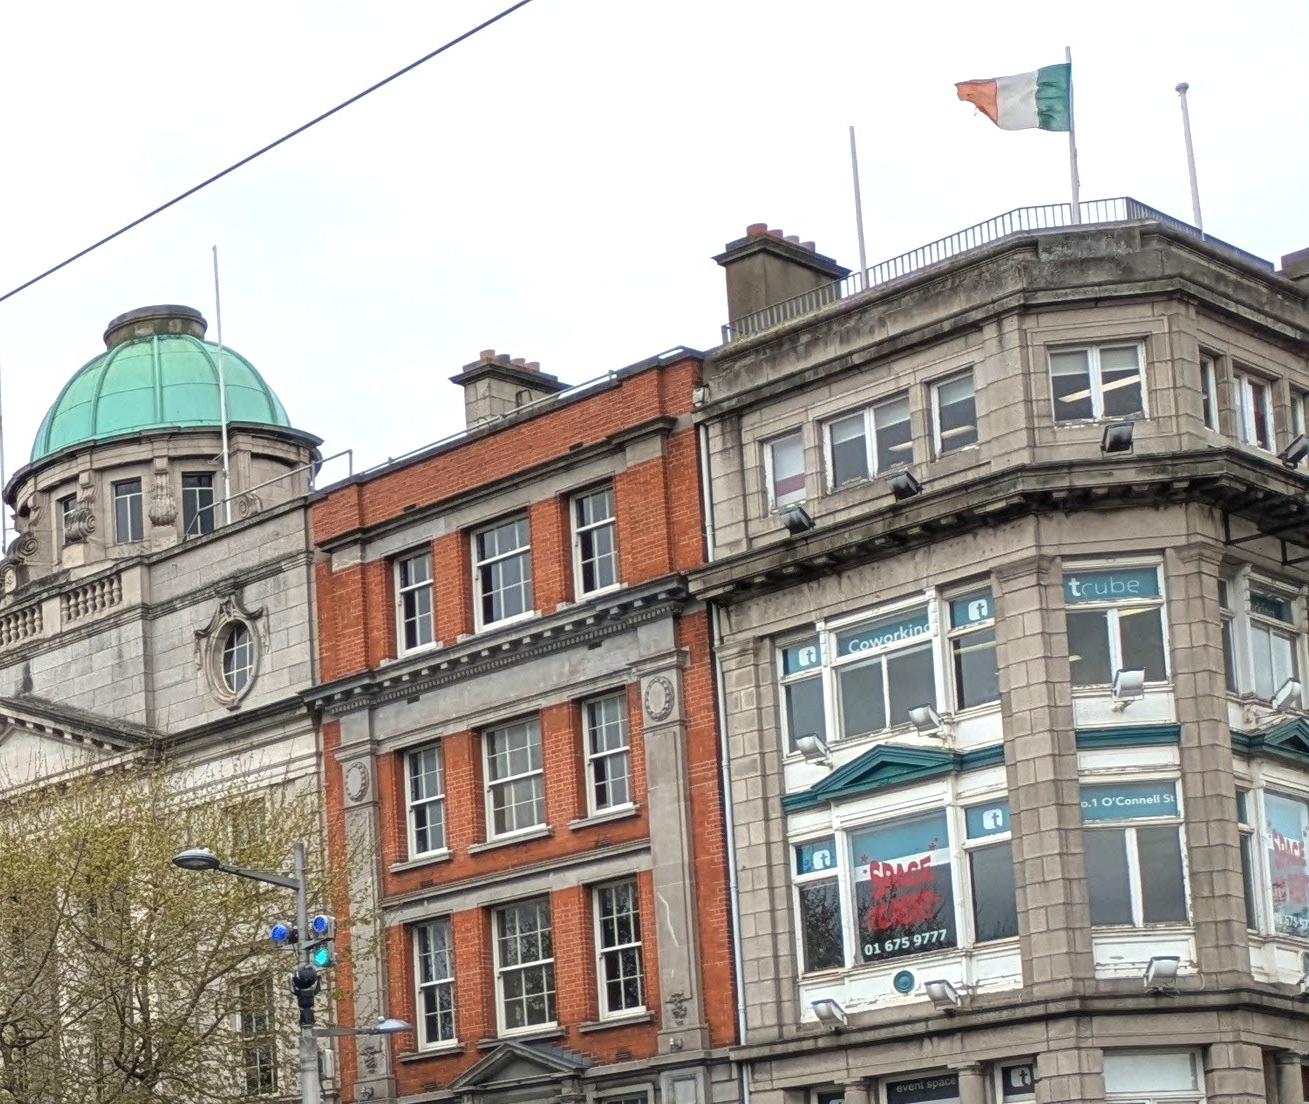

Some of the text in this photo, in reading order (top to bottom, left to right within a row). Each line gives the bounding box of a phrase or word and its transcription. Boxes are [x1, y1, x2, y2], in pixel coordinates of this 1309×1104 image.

[1080, 794, 1175, 808] o.1 O'Connell St
[864, 929, 948, 956] 01 675 9777
